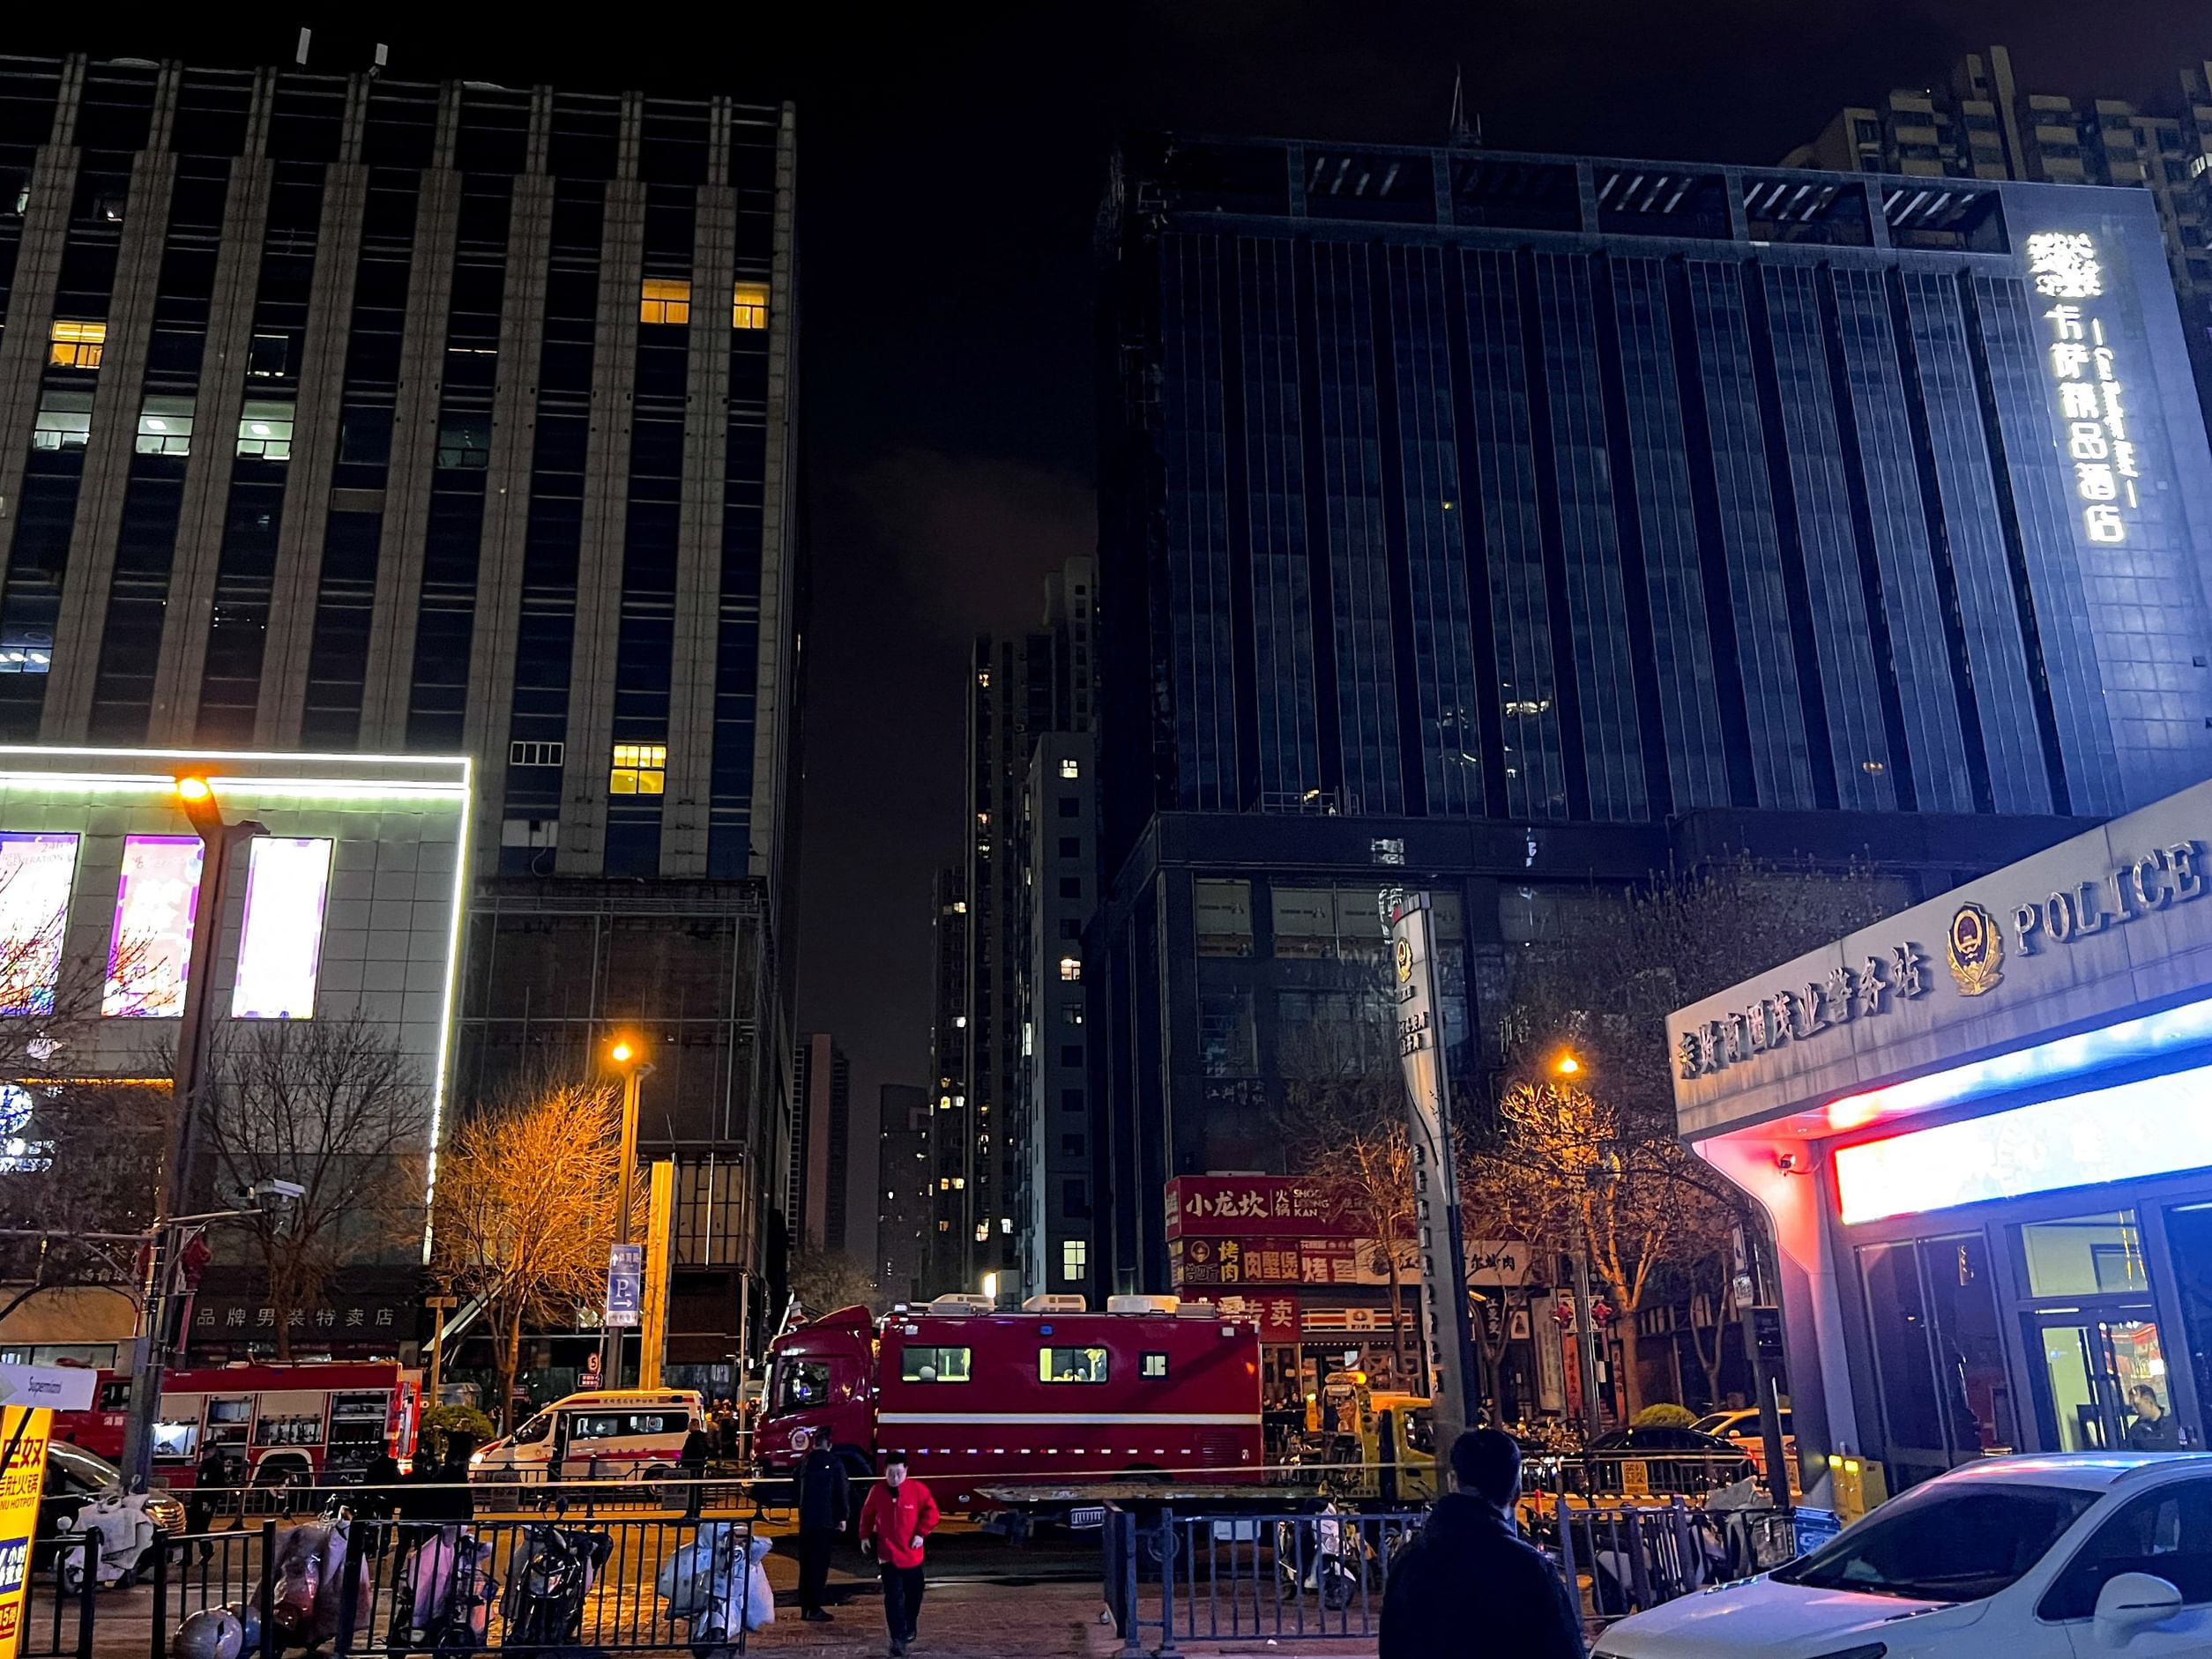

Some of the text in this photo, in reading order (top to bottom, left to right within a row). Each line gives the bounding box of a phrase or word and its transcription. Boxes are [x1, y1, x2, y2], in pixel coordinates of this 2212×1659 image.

[2010, 840, 2201, 957] POLICE
[1186, 1190, 1270, 1218] 小龙坎
[1275, 1189, 1290, 1216] 火锅
[1293, 1209, 1318, 1217] KAN
[1218, 1240, 1240, 1283] 烤肉
[1244, 1252, 1300, 1279] 肉蟹煲
[616, 1278, 629, 1298] P
[197, 1307, 394, 1327] 品牌男装特卖店
[3, 1437, 44, 1469] 巴奴
[11, 1497, 35, 1510] HOTPOT
